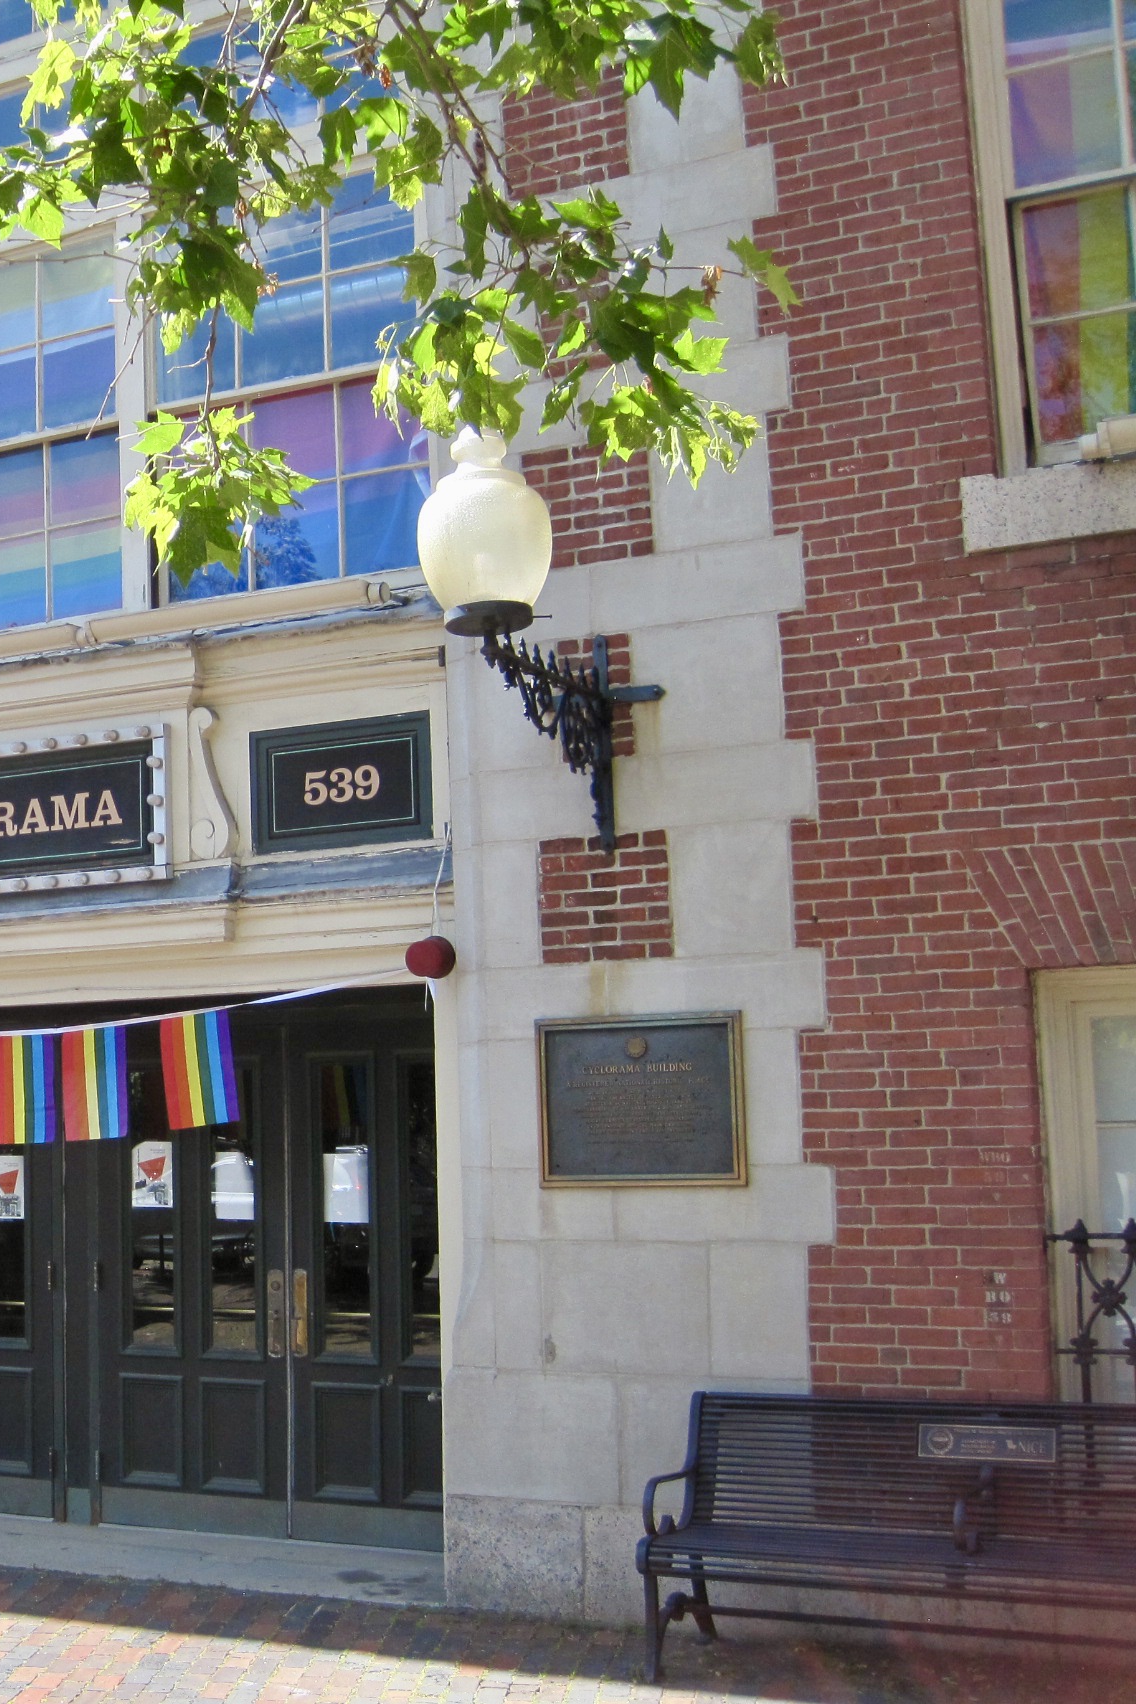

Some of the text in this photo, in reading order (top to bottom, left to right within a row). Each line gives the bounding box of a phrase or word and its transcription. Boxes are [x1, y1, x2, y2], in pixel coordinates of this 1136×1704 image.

[304, 765, 380, 806] 539
[582, 1062, 692, 1075] CYCLORAMA BUILDING
[993, 1272, 1007, 1285] W
